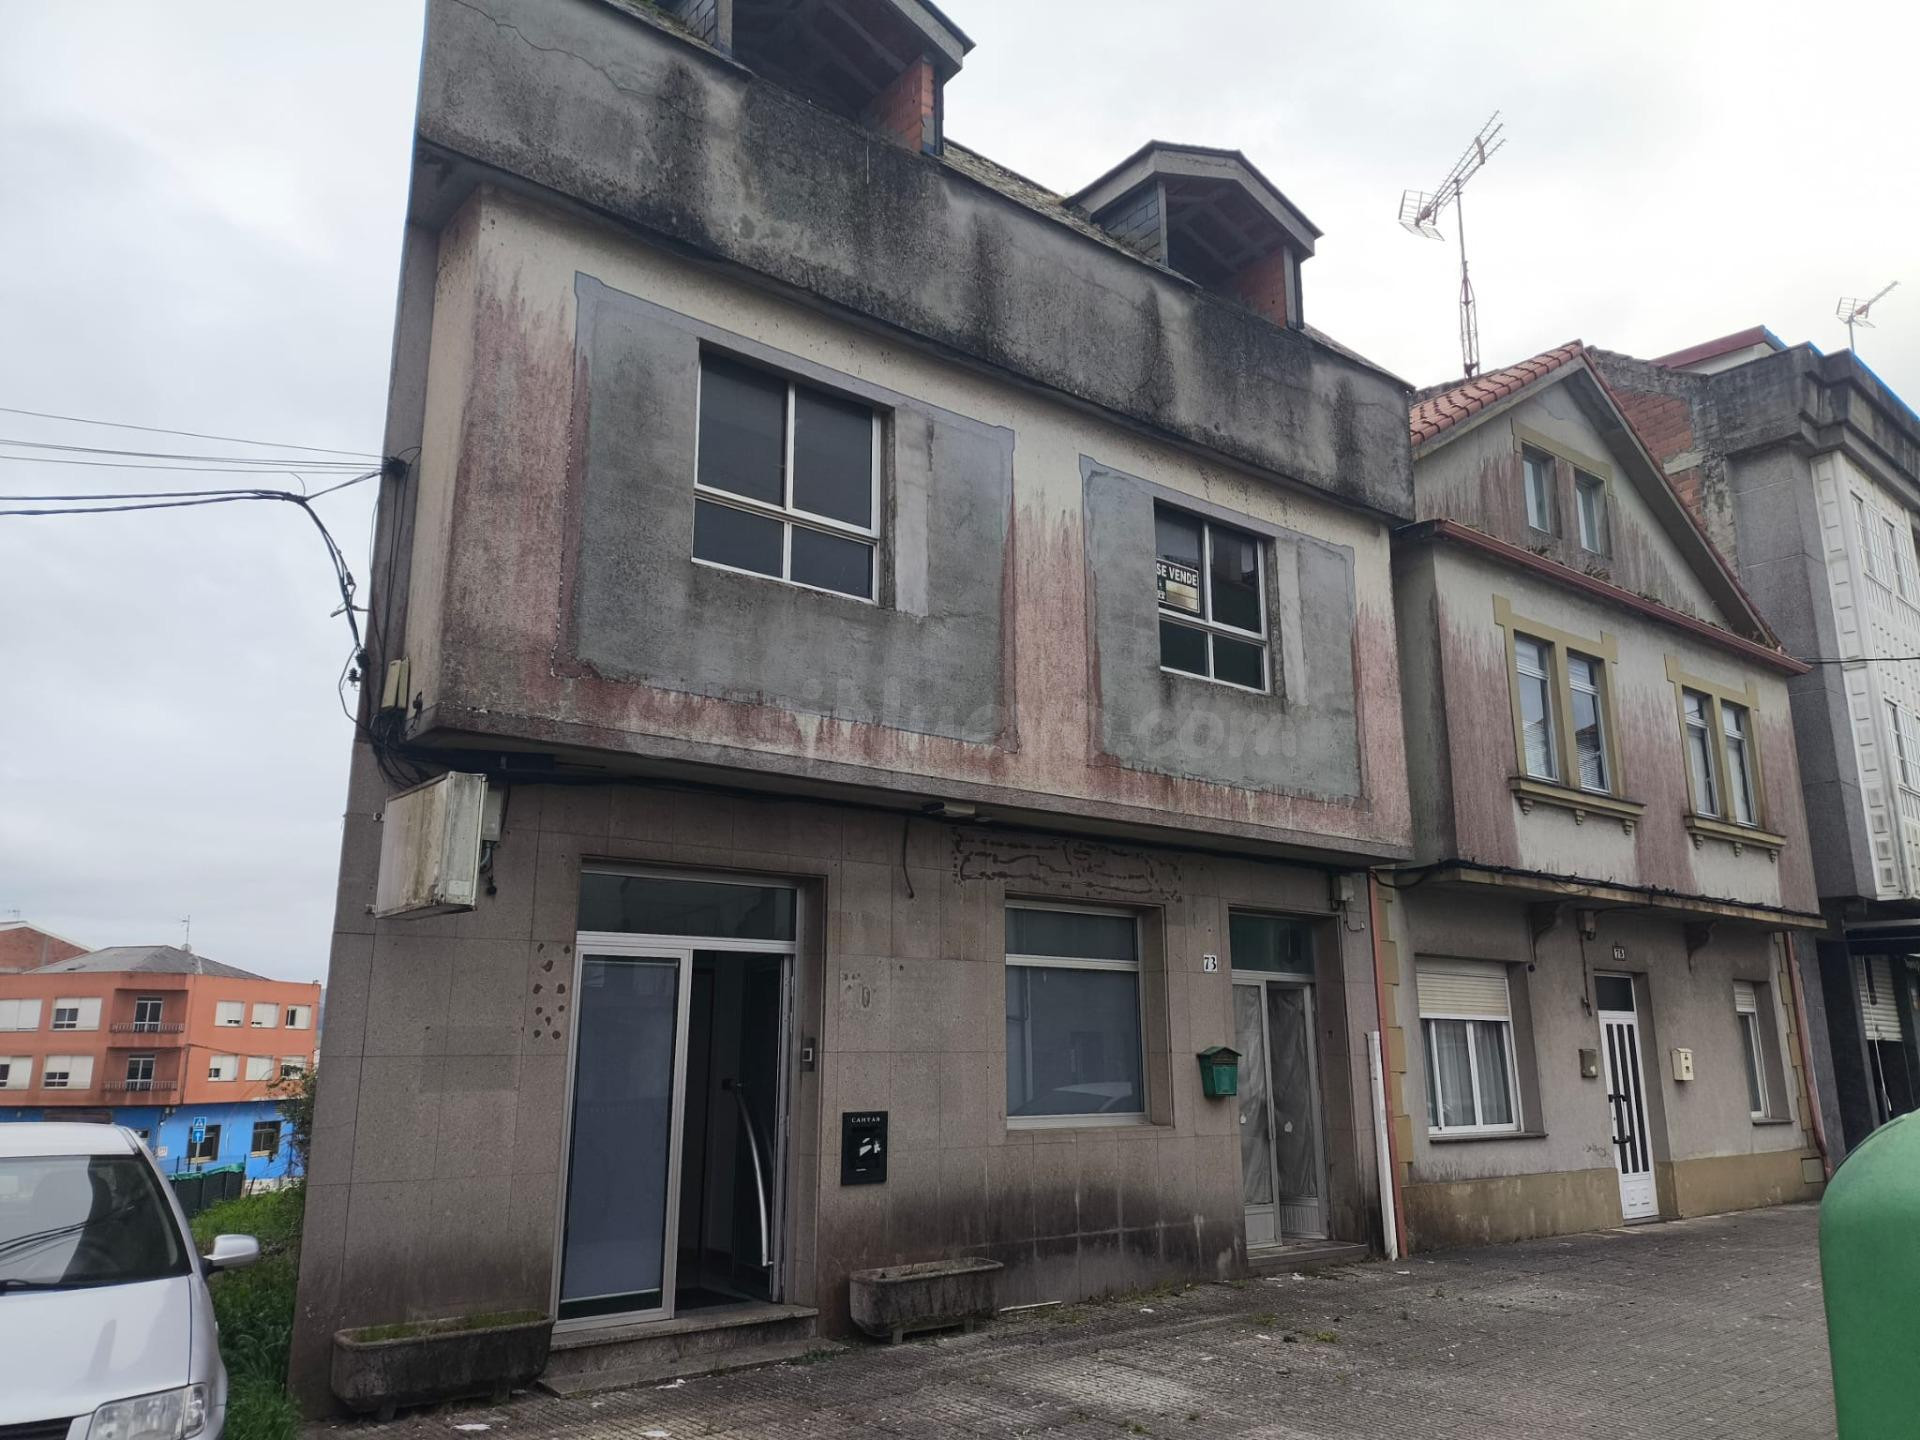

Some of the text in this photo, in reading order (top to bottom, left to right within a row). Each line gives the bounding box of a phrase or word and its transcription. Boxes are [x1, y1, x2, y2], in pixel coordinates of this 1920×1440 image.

[1156, 562, 1198, 587] SE VENDE
[1204, 956, 1217, 970] 73
